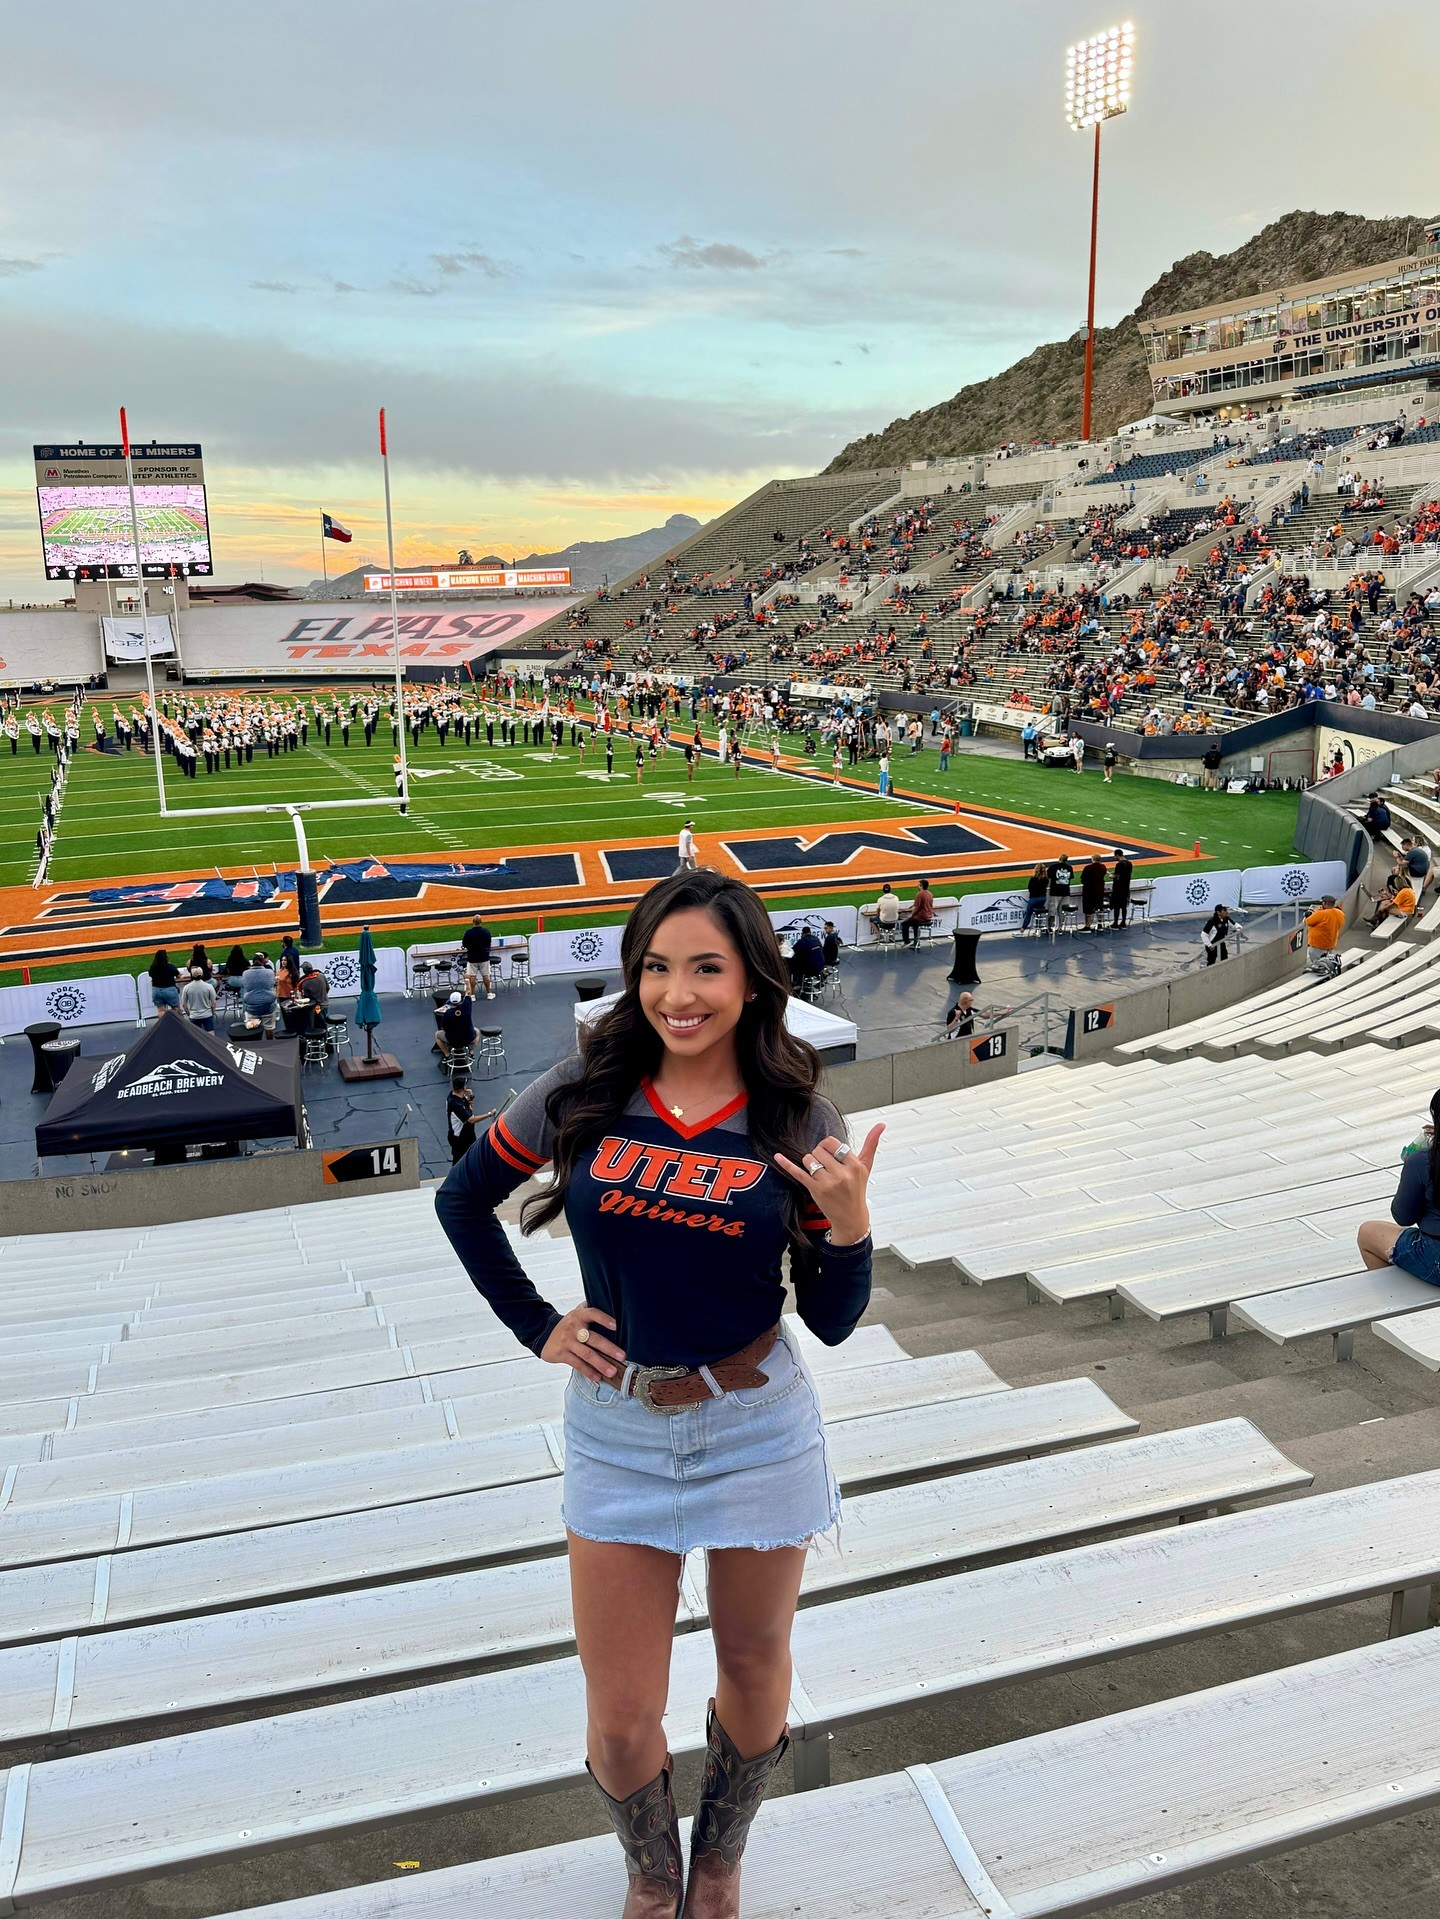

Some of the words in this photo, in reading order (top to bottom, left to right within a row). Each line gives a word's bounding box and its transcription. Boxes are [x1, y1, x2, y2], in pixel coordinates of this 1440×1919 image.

[1398, 261, 1417, 273] HUNT
[1293, 332, 1321, 348] THE
[1325, 311, 1420, 342] UNIVERSITY
[60, 448, 97, 457] HOME
[99, 448, 117, 456] OF
[145, 447, 196, 456] MINERS
[450, 575, 479, 586] MARCHING
[480, 574, 500, 585] MINERS
[518, 573, 546, 583] MARCHING
[546, 571, 565, 581] MINERS
[163, 586, 174, 594] 40
[278, 616, 355, 642] EL
[352, 613, 525, 641] PASO
[286, 642, 475, 660] TEXAS
[971, 911, 1007, 926] DEADBEACH
[570, 931, 604, 949] DEADBEACH
[571, 948, 603, 963] BREWERY
[324, 955, 361, 975] DEADBEACH
[45, 986, 87, 1006] DEADBEACH
[47, 1004, 87, 1021] BREWERY
[1087, 1012, 1099, 1030] 12
[988, 1035, 1002, 1056] 13
[117, 1080, 173, 1099] DEADBEACH
[176, 1075, 224, 1089] BREWERY
[370, 1147, 398, 1175] 14
[590, 1136, 768, 1204] UTEP
[55, 1185, 75, 1199] NO
[598, 1189, 746, 1236] Miners
